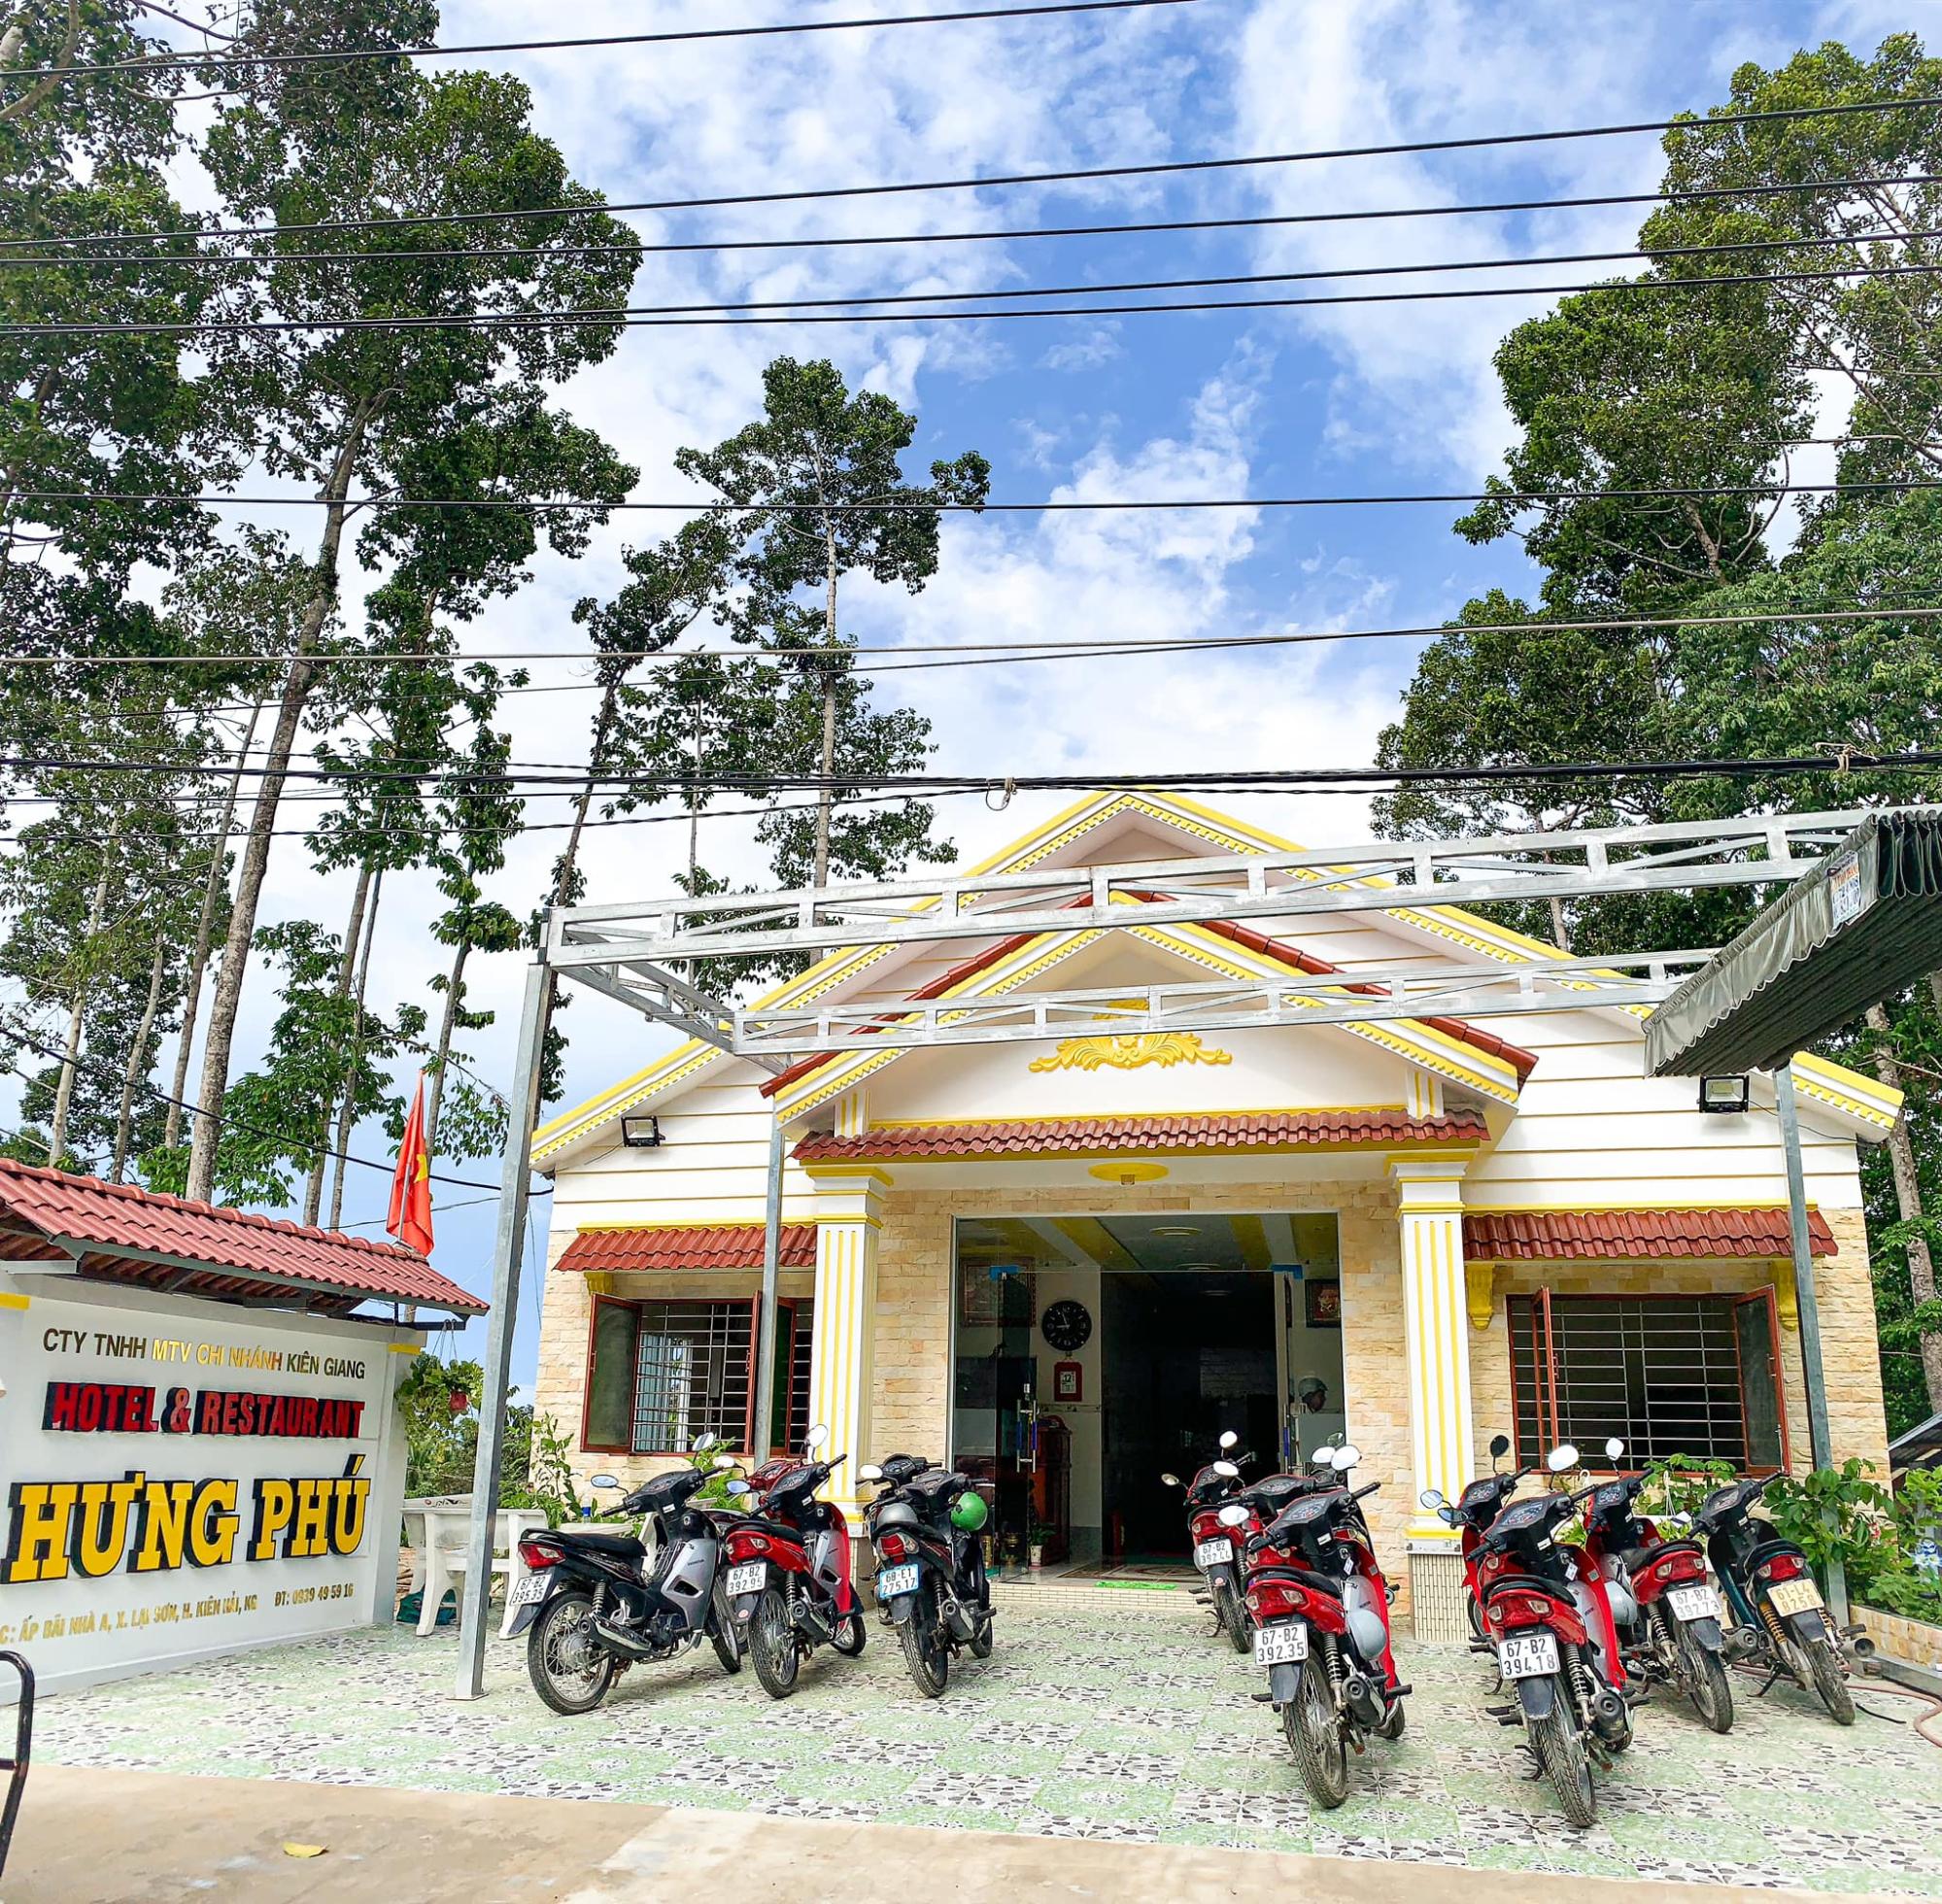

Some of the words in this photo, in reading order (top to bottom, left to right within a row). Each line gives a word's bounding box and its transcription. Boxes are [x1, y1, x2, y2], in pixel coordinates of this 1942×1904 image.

[43, 1327, 87, 1354] CTY
[94, 1333, 147, 1359] TNHH
[153, 1339, 192, 1363] MTV
[196, 1343, 225, 1367] CHI
[229, 1345, 283, 1371] NHÁNH
[287, 1350, 320, 1375] KIÊN
[324, 1357, 366, 1379] GIANG
[42, 1381, 159, 1432] HOTEL
[160, 1386, 192, 1433] &
[193, 1390, 366, 1439] RESTAURANT
[0, 1470, 240, 1584] HƯNG
[246, 1453, 371, 1562] PHÚ
[733, 1565, 761, 1581] 67-B2
[729, 1576, 763, 1593] 392.95
[1675, 1588, 1710, 1605] 67-B2
[69, 1611, 95, 1635] NHÀ
[196, 1595, 221, 1617] KIÊN
[244, 1594, 257, 1611] KG
[274, 1590, 290, 1607] ĐT:
[291, 1587, 316, 1605] 0939
[318, 1585, 329, 1601] 49
[330, 1583, 342, 1599] 59
[1262, 1627, 1299, 1646] 67-B2
[1257, 1642, 1305, 1662] 392.35
[1506, 1638, 1547, 1657] 67-B2
[1504, 1653, 1555, 1676] 394.18
